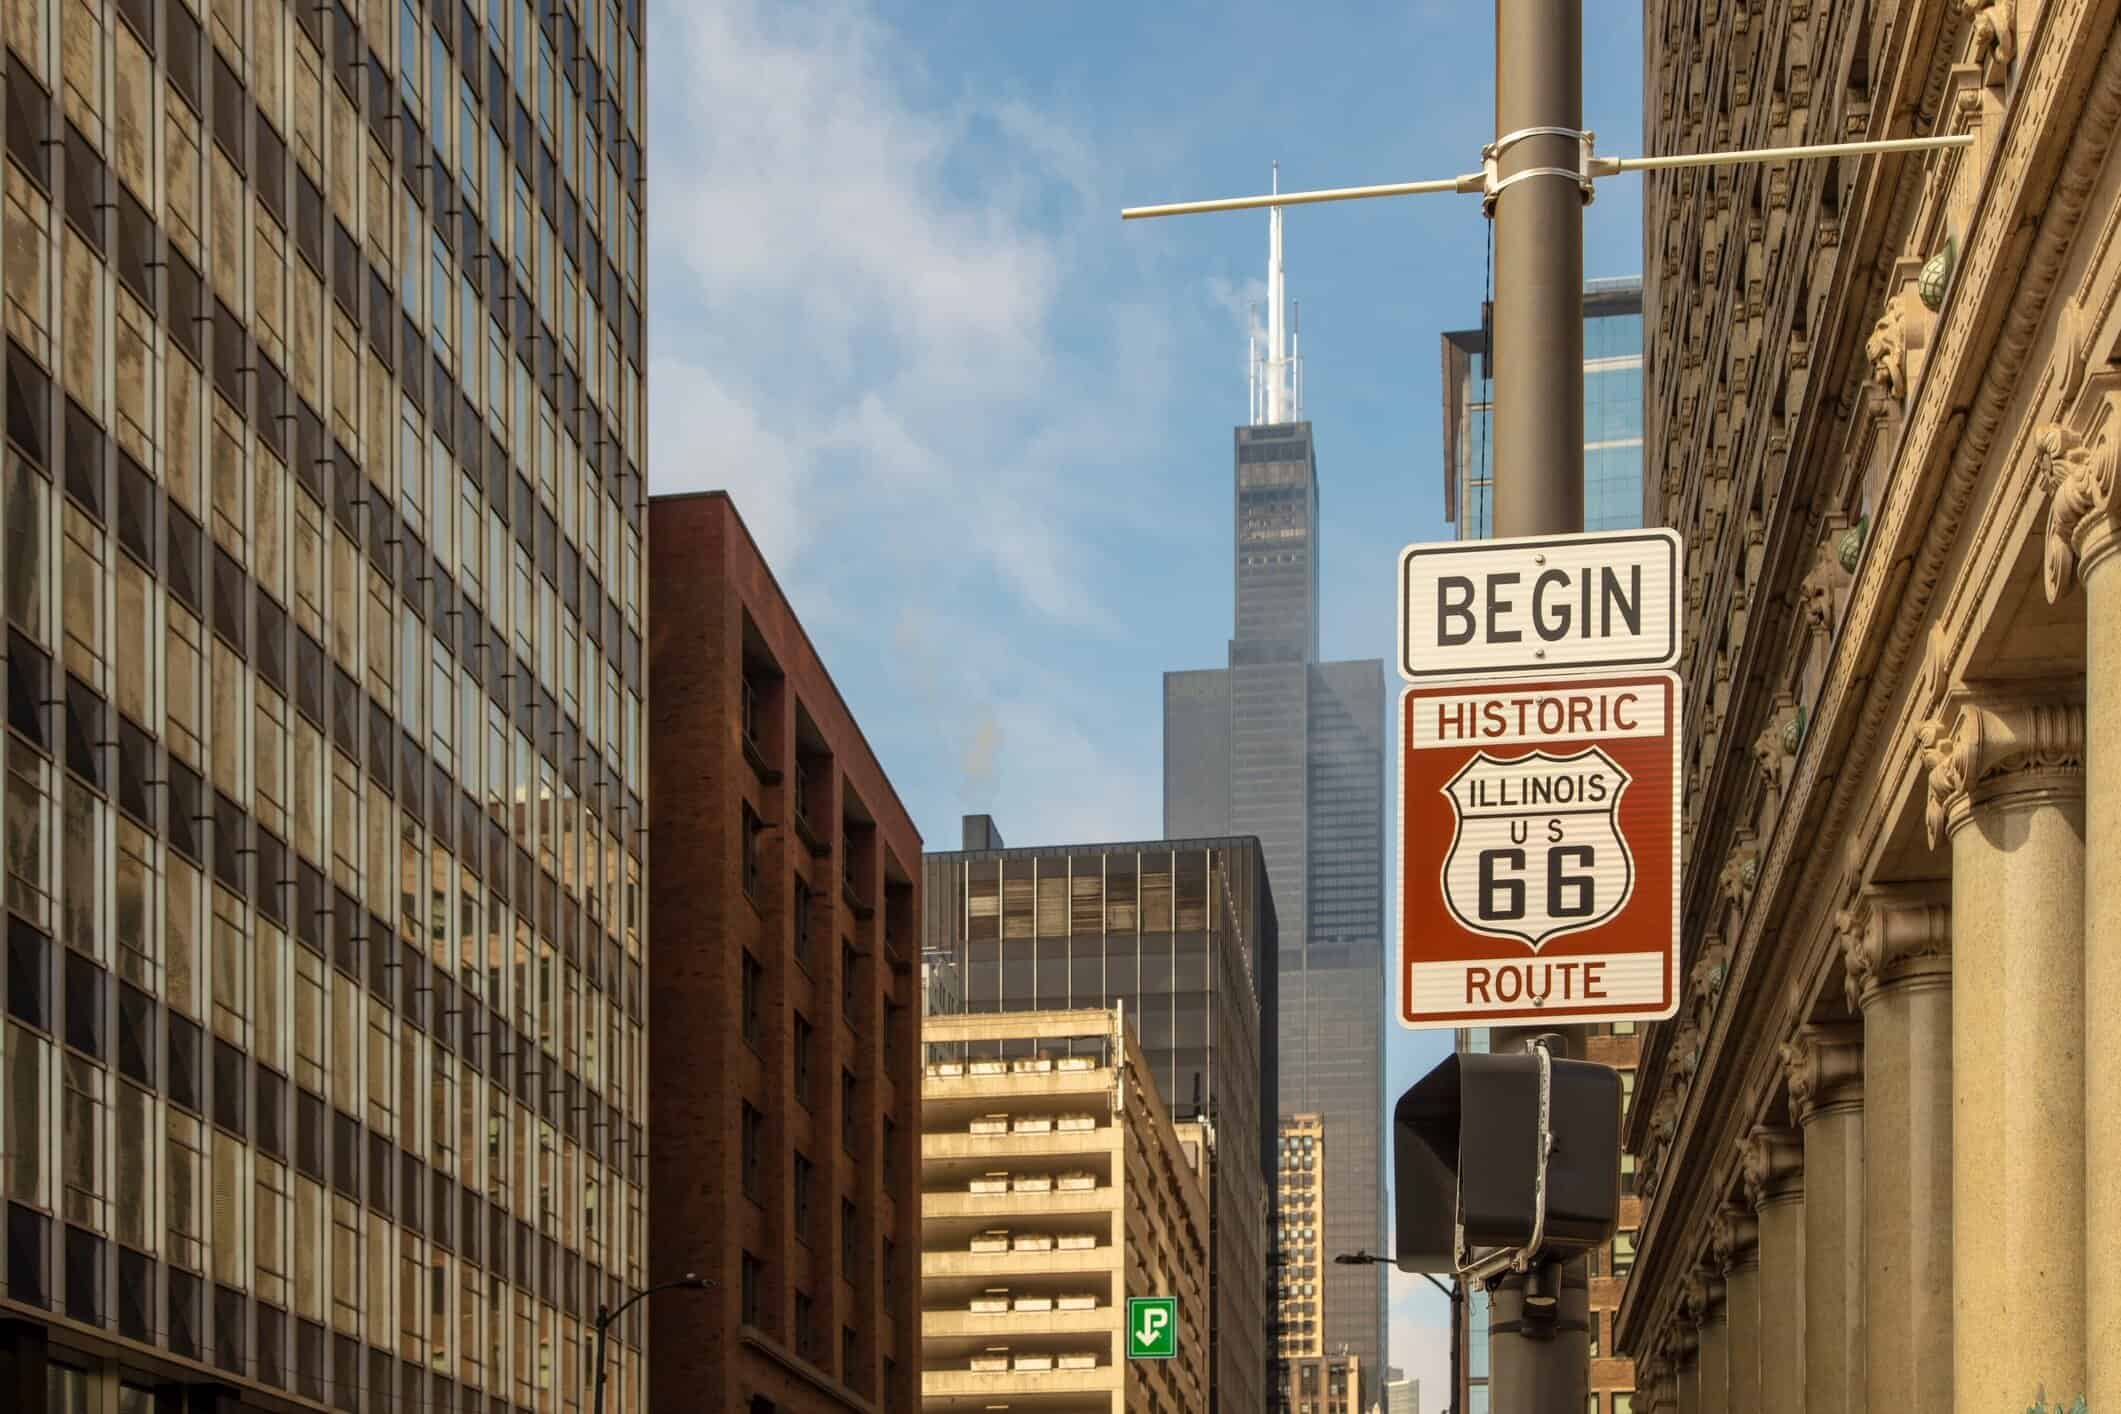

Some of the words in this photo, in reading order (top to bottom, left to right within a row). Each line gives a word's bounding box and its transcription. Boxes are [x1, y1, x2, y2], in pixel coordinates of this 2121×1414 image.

[1437, 564, 1642, 646] BEGIN
[1438, 693, 1639, 740] HISTORIC
[1469, 773, 1607, 808] ILLINOIS
[1478, 844, 1595, 921] 66
[1466, 961, 1608, 1003] ROUTE
